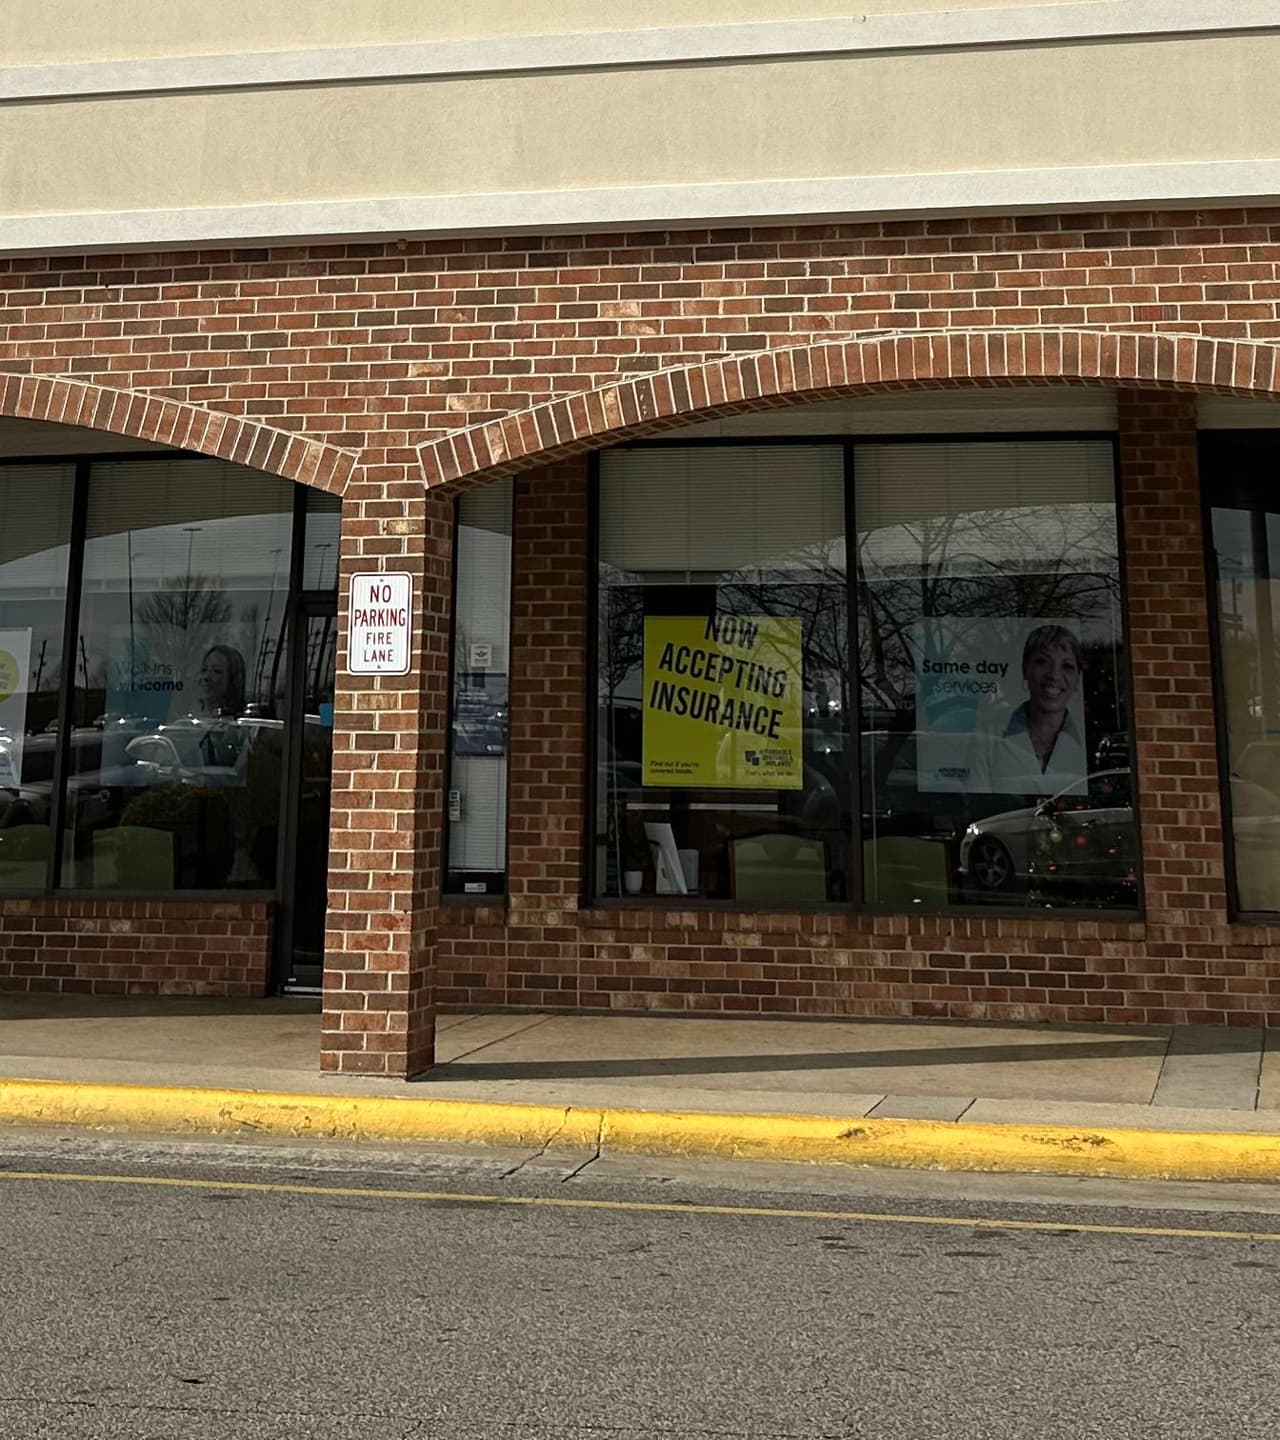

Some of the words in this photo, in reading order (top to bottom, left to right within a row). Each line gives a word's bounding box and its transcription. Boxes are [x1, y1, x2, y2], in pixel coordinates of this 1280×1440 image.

[369, 584, 392, 604] NO
[353, 608, 406, 628] PARKING
[365, 632, 393, 646] FIRE
[704, 615, 758, 651] NOW
[363, 649, 395, 663] LANE
[658, 642, 789, 699] ACCEPTING
[923, 659, 970, 674] Same
[976, 659, 1009, 678] day
[935, 680, 998, 694] services
[649, 679, 785, 740] INSURANCE
